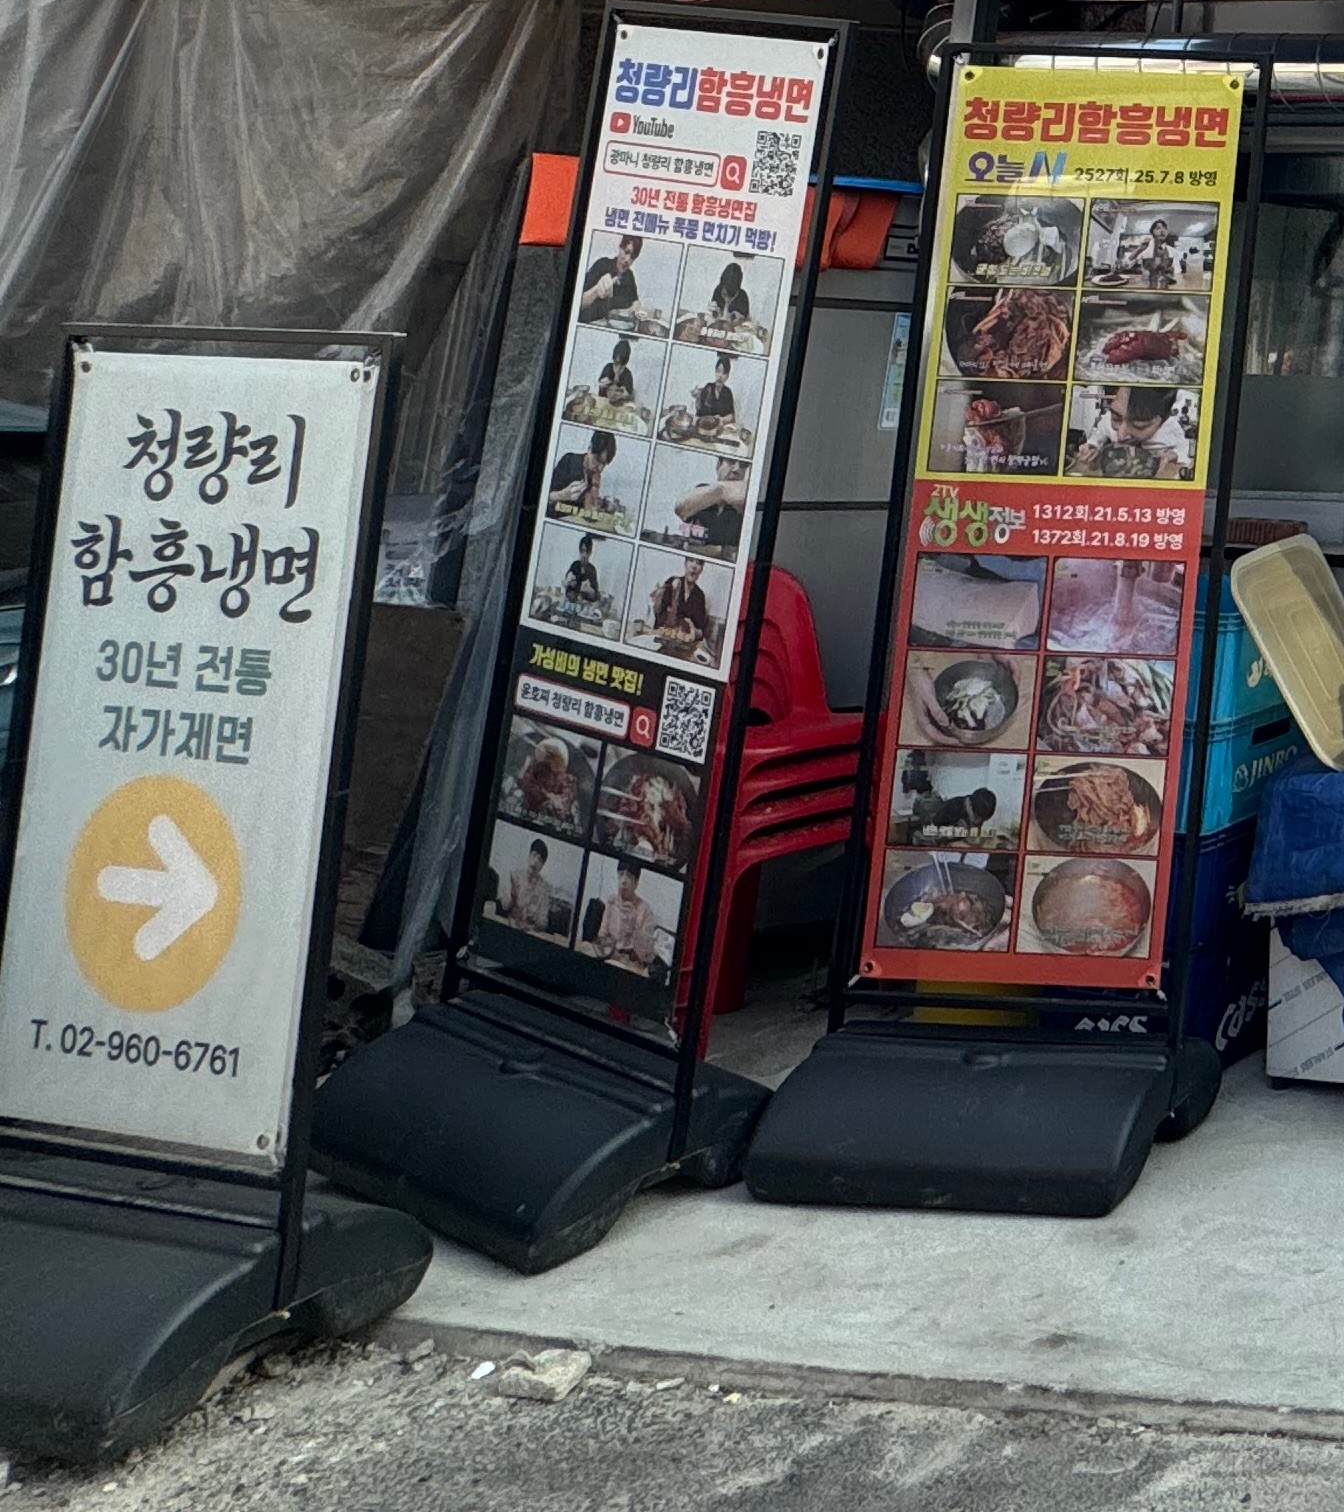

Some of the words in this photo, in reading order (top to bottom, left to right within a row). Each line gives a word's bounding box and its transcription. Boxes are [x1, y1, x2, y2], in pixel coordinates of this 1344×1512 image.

[614, 58, 814, 124] 청량리함흥냉면
[633, 115, 675, 139] YouTube
[963, 96, 1230, 148] 청량리함흥냉면
[642, 153, 671, 172] 청량리
[674, 158, 714, 177] 함흥냉면
[1189, 170, 1218, 187] 방영
[630, 186, 660, 208] 30년
[663, 190, 689, 213] 전통
[691, 192, 758, 223] 함흥냉면집
[604, 207, 631, 229] 냉면
[702, 221, 742, 248] 면치기
[745, 227, 778, 253] 먹방!
[122, 407, 308, 508] 청량리
[1156, 507, 1186, 526] 방영
[1153, 532, 1184, 551] 방영
[70, 512, 322, 625] 함흥냉면
[95, 638, 183, 691] 30년
[194, 641, 274, 698] 전통
[582, 658, 610, 685] 냉면
[551, 691, 582, 716] 청량리
[584, 700, 625, 728] 함흥냉면
[98, 705, 254, 766] 자가제면
[30, 1018, 53, 1055] T.
[60, 1022, 241, 1077] 02-960-6761
